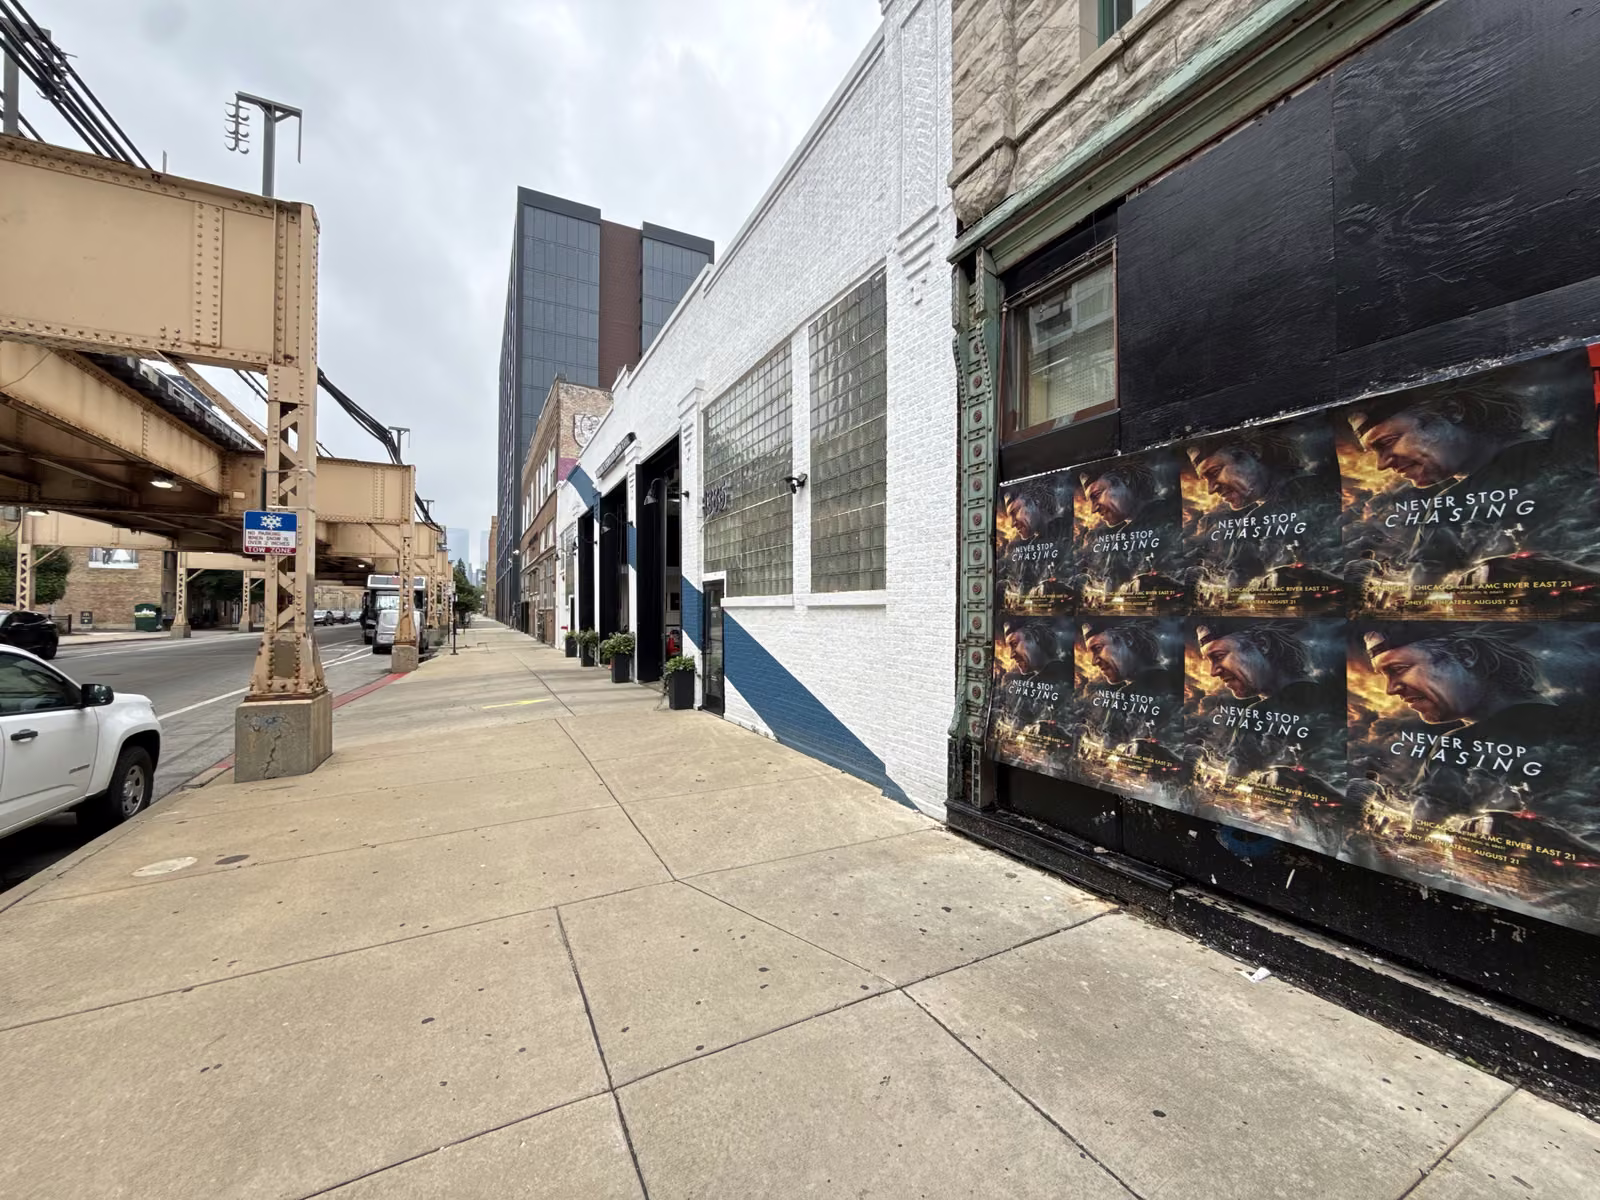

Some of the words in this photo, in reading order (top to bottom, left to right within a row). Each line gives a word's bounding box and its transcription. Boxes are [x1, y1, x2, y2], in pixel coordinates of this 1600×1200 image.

[1396, 495, 1455, 512] NEVER
[1466, 488, 1519, 504] STOP
[1218, 517, 1256, 529] NEVER
[1263, 513, 1297, 524] STOP
[1385, 500, 1535, 528] CHASING
[1098, 532, 1128, 544] NEVER
[1130, 530, 1153, 540] STOP
[1210, 522, 1306, 541] CHASING
[1014, 544, 1035, 553] NEVER
[1093, 537, 1160, 553] CHASING
[1012, 550, 1058, 562] CHASING
[1008, 686, 1059, 700] CHASING
[1013, 680, 1034, 688] NEVER
[1037, 683, 1053, 691] STOP
[1093, 697, 1160, 715] CHASING
[1098, 690, 1125, 700] NEVER
[1130, 694, 1154, 704] STOP
[1220, 705, 1259, 719] NEVER
[1266, 711, 1300, 724] STOP
[1212, 714, 1309, 738] CHASING
[1401, 731, 1462, 750] NEVER
[1473, 740, 1526, 758] STOP
[1390, 742, 1543, 776] CHASING
[1286, 788, 1302, 796] RIVER
[1304, 792, 1318, 800] EAST
[1403, 832, 1422, 840] ONLY
[1474, 849, 1507, 861] AUGUST
[1415, 820, 1456, 832] CHICAGO
[1480, 834, 1502, 844] AMC
[1506, 839, 1532, 850] RIVER
[1536, 846, 1561, 857] EAST
